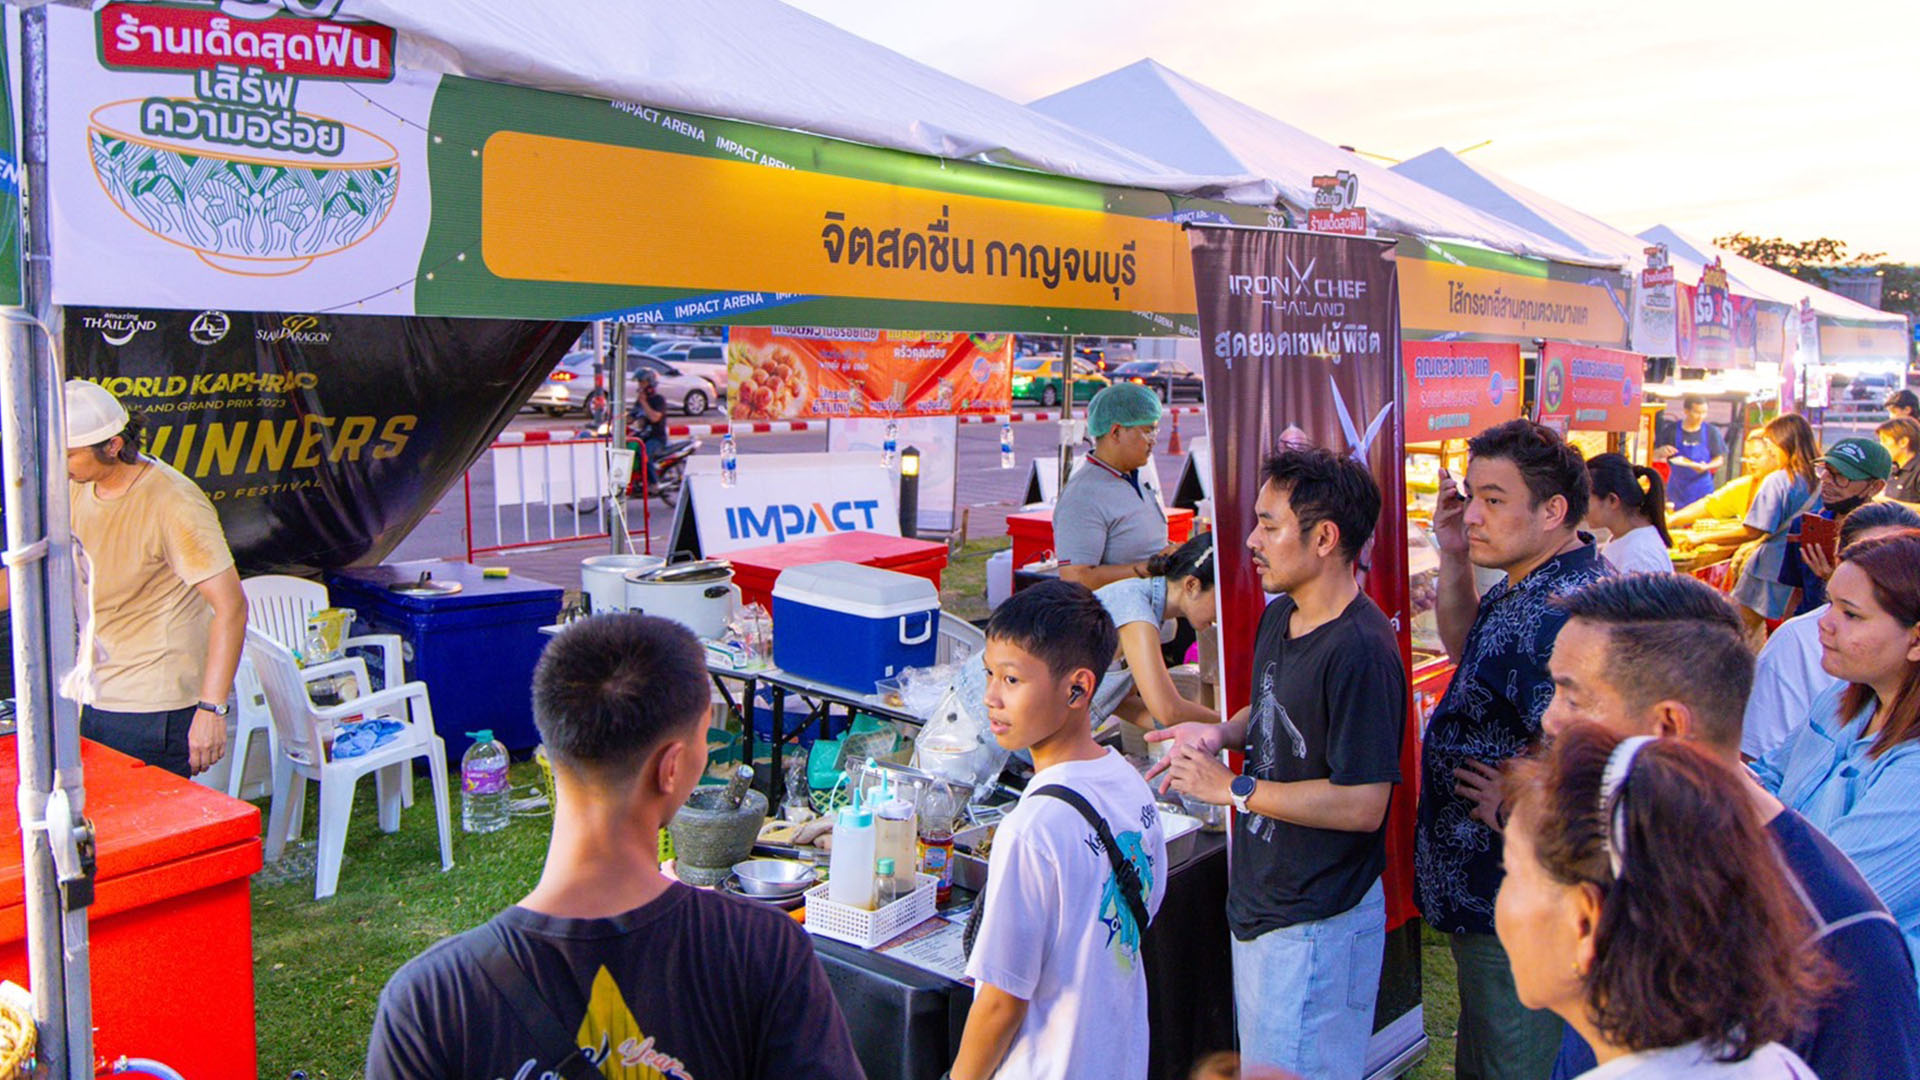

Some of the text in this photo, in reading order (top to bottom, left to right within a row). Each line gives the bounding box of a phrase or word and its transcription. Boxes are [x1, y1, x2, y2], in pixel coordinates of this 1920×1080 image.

[115, 13, 381, 70] ร้านเด็ดสุดฟิน
[199, 64, 293, 109] เสิร์ฟ
[147, 102, 340, 151] ความอร่อย
[662, 116, 705, 142] ARENA
[716, 136, 758, 162] IMPACT
[821, 205, 1137, 301] จิตสดชื่น กาญจนบุรี
[1229, 275, 1366, 299] IRON CHEF
[674, 299, 720, 319] IMPACT
[723, 292, 764, 310] ARENA
[1262, 300, 1345, 317] THAILAND
[82, 316, 157, 331] THAILAND
[190, 371, 319, 396] KAPHRAO
[177, 400, 225, 412] GRAND
[226, 399, 254, 409] PRIX
[256, 398, 287, 408] 2023
[140, 414, 418, 479] INNERS
[725, 500, 879, 543] IMPACT
